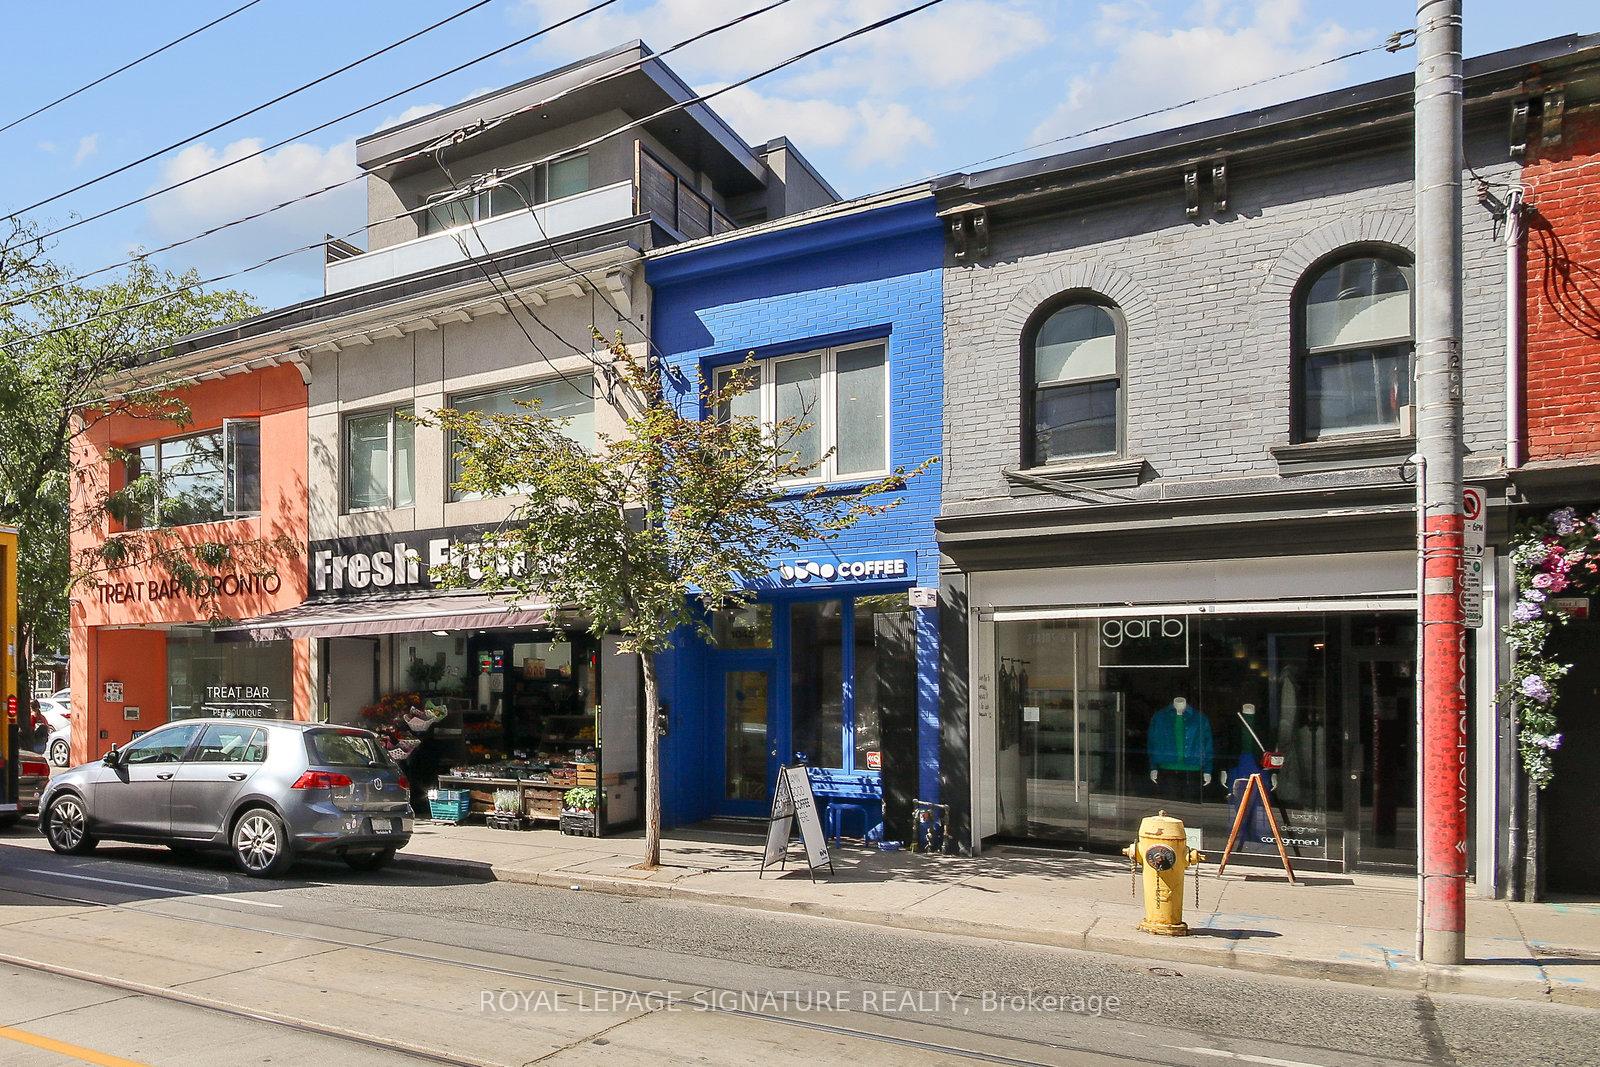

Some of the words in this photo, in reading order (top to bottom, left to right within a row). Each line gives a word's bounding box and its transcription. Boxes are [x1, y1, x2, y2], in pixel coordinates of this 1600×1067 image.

[314, 542, 419, 590] Fresh
[837, 558, 905, 578] COFFEE
[97, 581, 144, 604] TREAT
[148, 579, 181, 601] BAR
[1102, 615, 1184, 648] garb
[206, 686, 242, 698] TREAT
[245, 686, 270, 698] BAR
